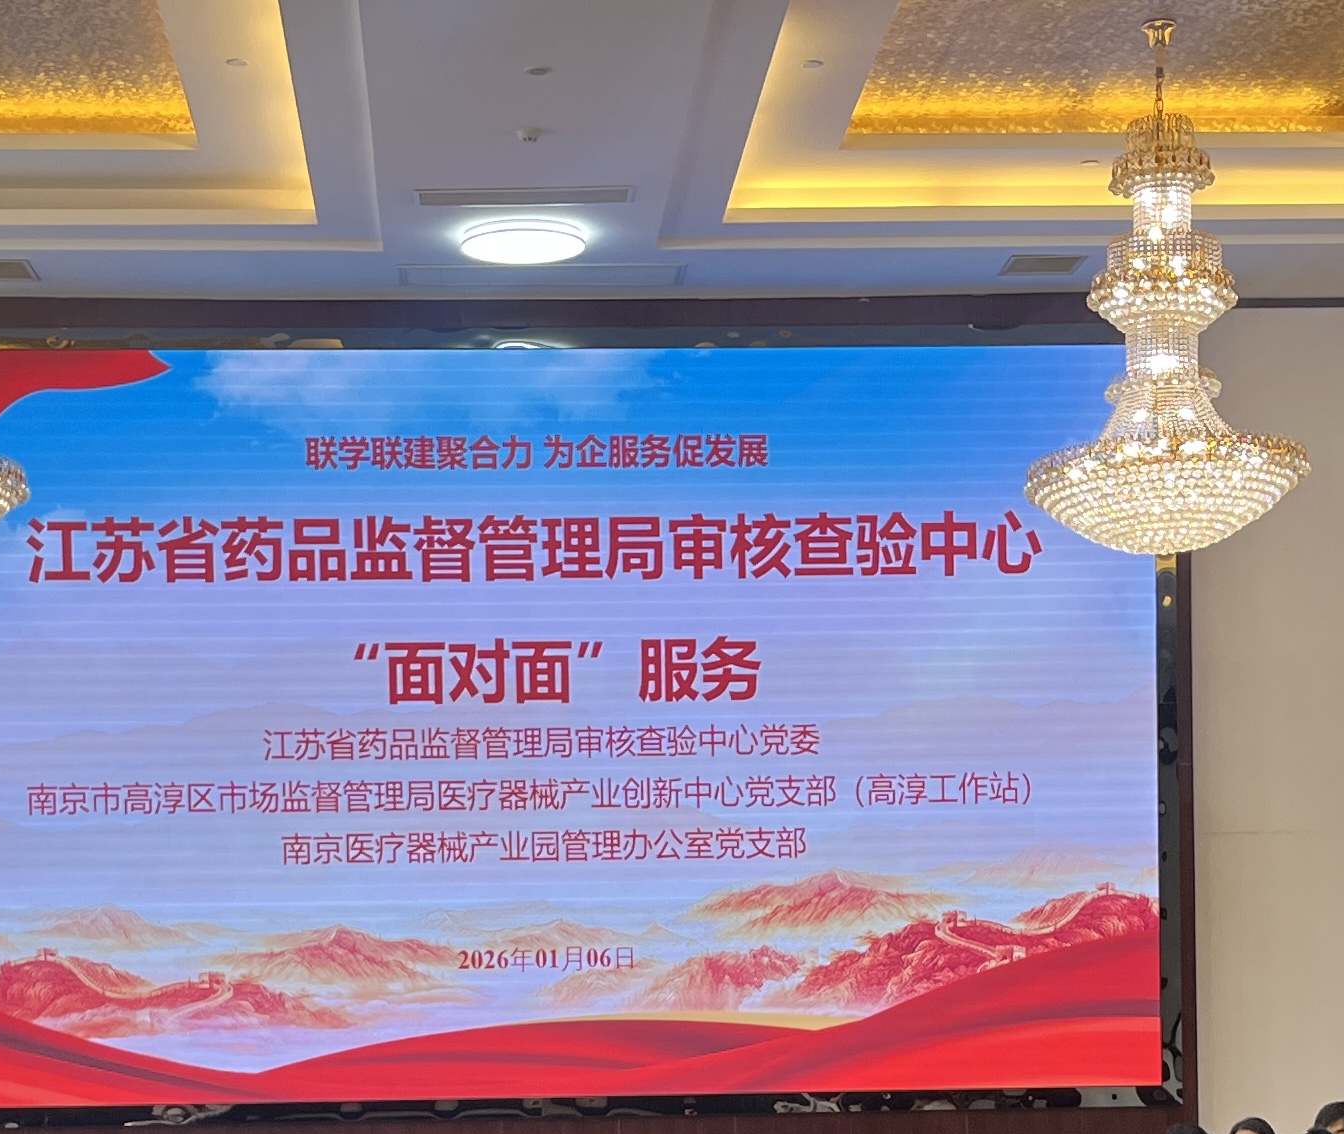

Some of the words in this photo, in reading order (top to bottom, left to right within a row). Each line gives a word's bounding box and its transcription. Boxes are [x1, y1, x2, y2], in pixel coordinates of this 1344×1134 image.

[304, 435, 532, 470] 联学联建聚合力
[543, 433, 769, 468] 为企服务促发展
[26, 509, 1044, 584] 江苏省药品监督管理局审核查验中心
[638, 635, 762, 702] 服务
[262, 723, 821, 761] 江苏省药品监督管理局审核查验中心党委
[281, 826, 807, 865] 南京医疗器械产业园管理办公室党支部
[458, 946, 636, 973] 2026年01月06日
